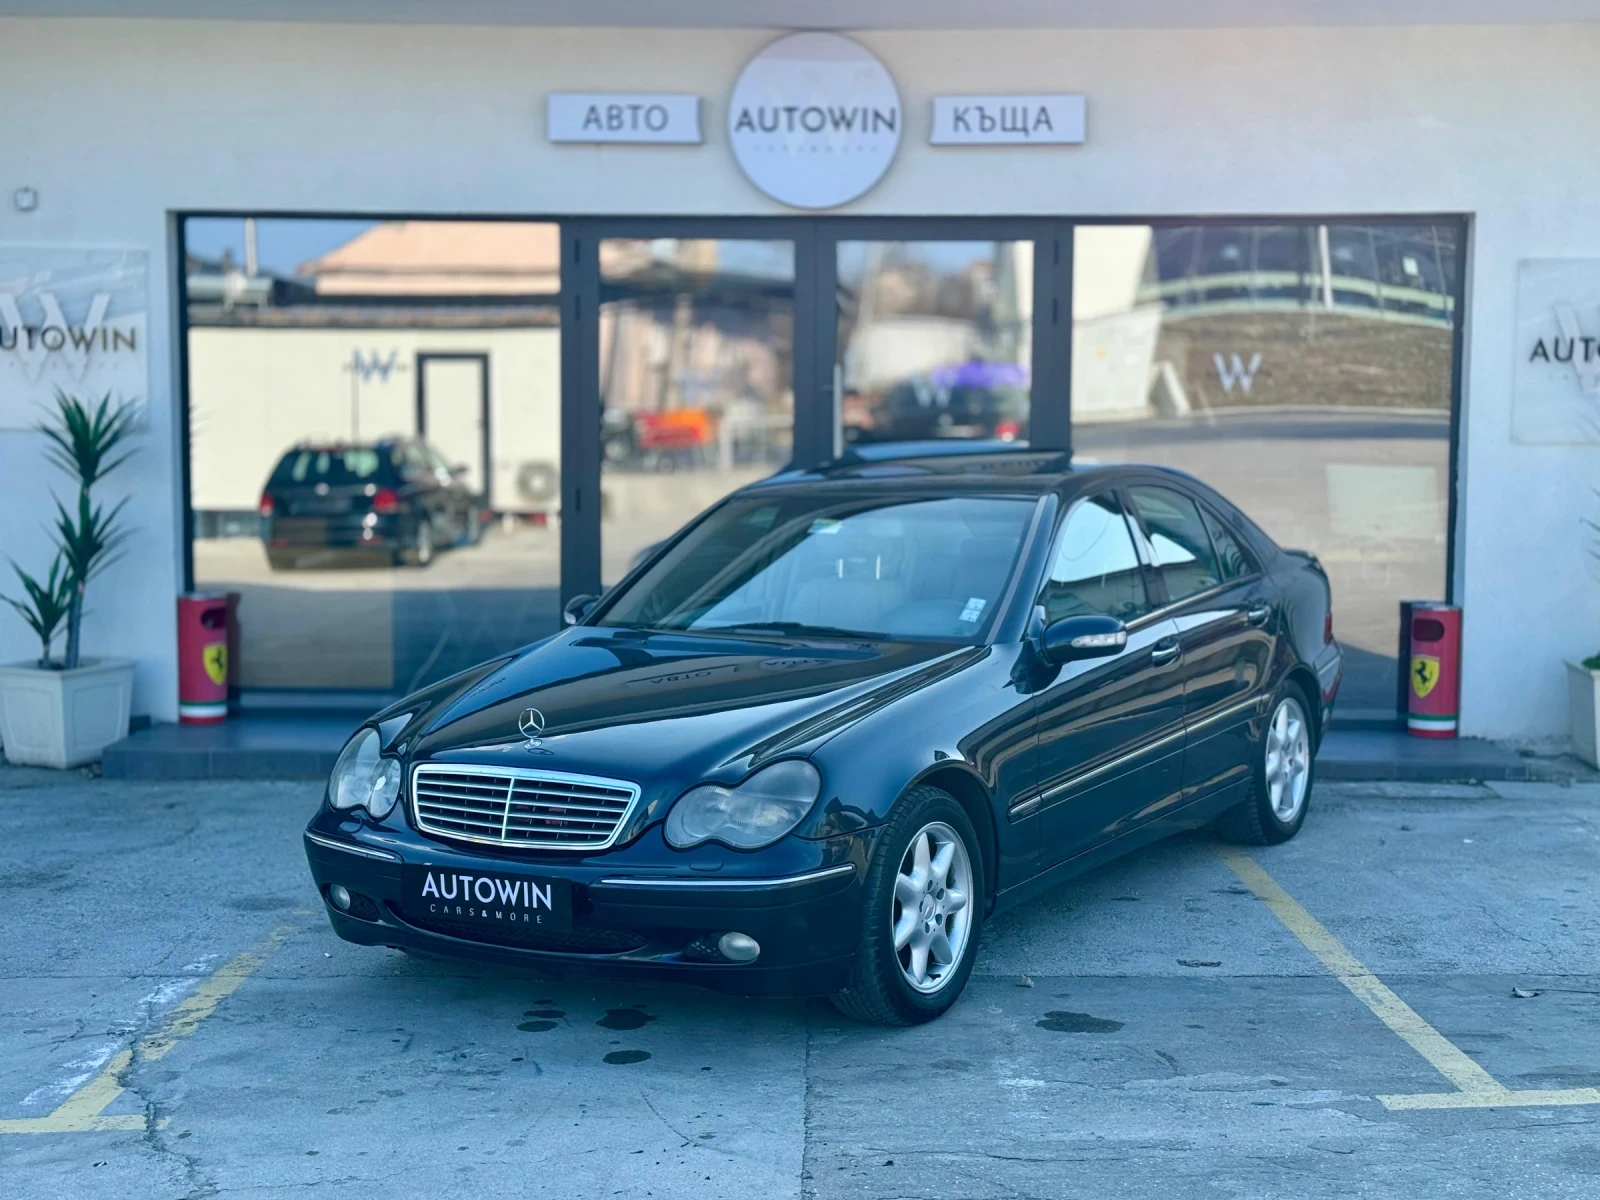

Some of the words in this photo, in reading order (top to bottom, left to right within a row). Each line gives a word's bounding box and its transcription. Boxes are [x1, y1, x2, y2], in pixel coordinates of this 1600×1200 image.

[582, 104, 669, 132] АВТО
[735, 106, 897, 133] AUTOWIN
[953, 106, 1054, 137] КЪЩА
[1529, 337, 1600, 362] AUT
[421, 871, 552, 910] AUTOWIN
